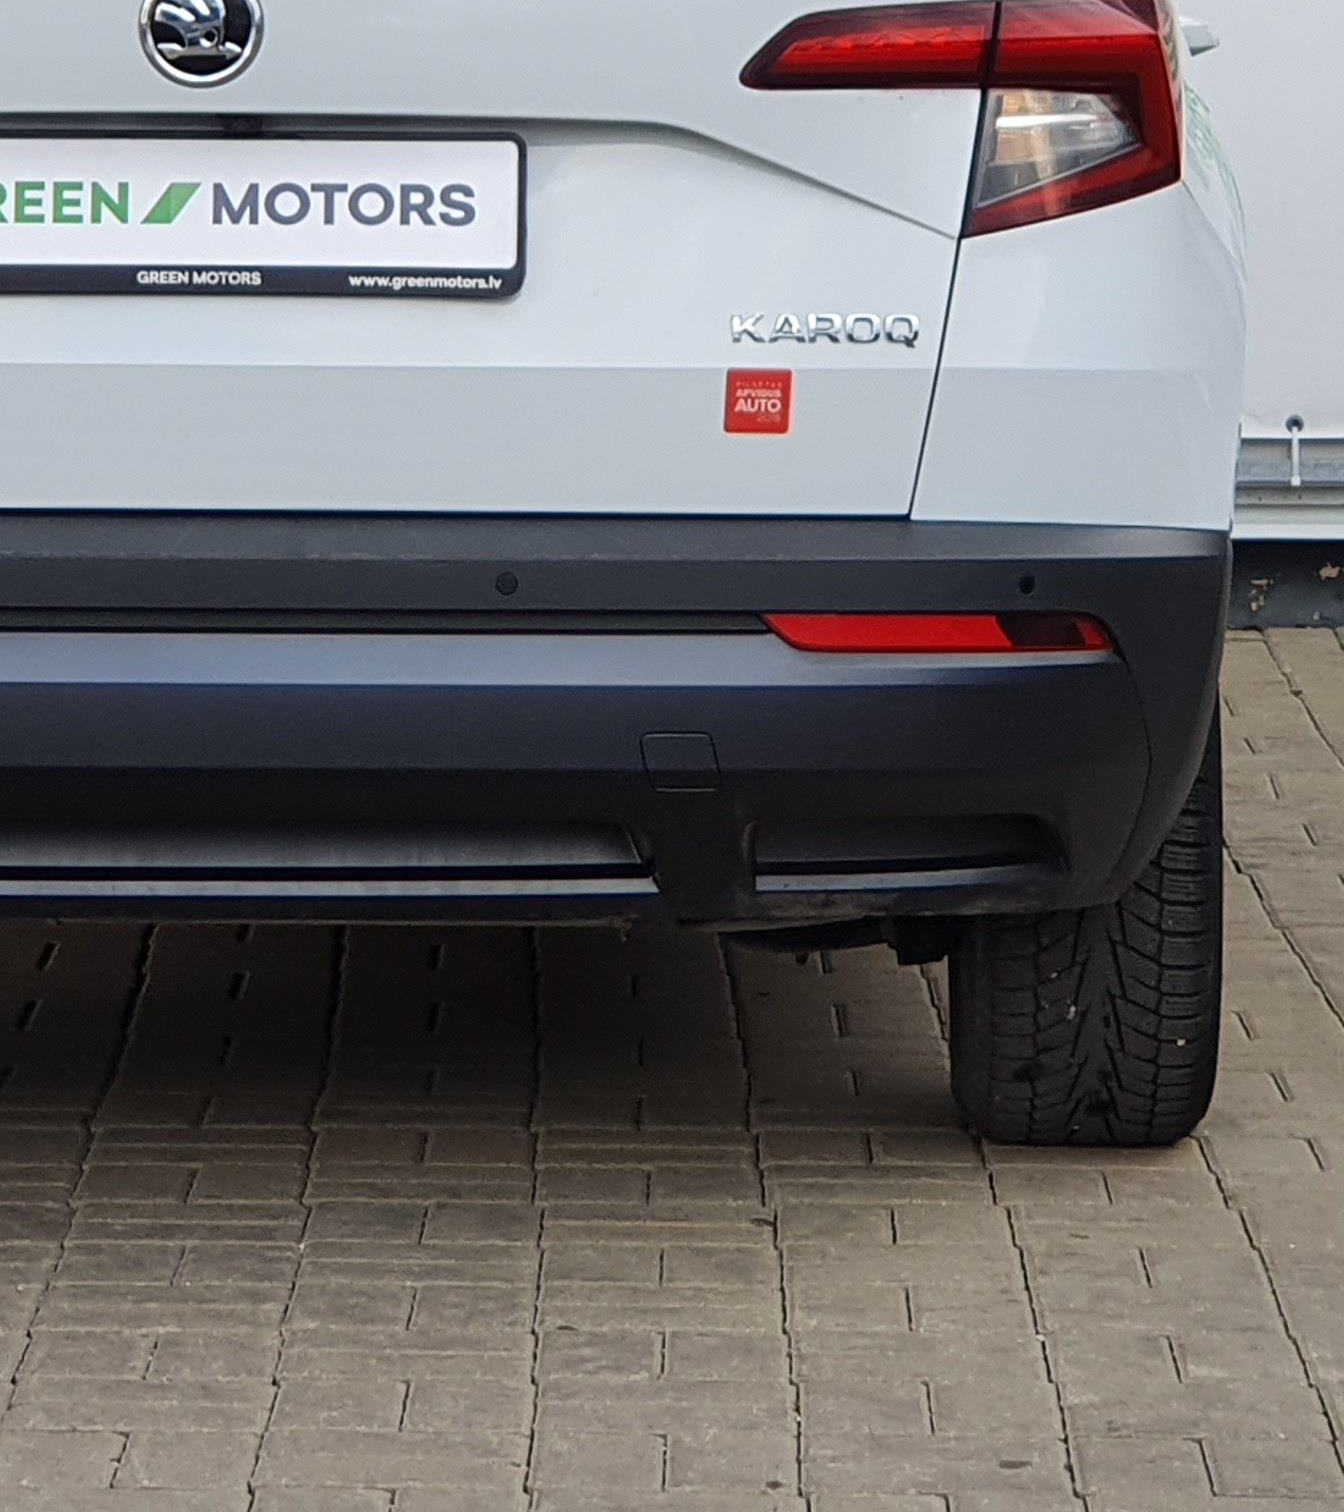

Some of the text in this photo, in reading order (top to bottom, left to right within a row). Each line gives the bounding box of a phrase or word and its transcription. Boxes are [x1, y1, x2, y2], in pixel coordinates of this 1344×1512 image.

[211, 181, 477, 227] MOTORS
[136, 270, 262, 286] GREEN MOTORS
[349, 274, 503, 290] www.greenmotors.lv
[730, 312, 920, 348] KAROQ
[734, 398, 782, 413] AUTO
